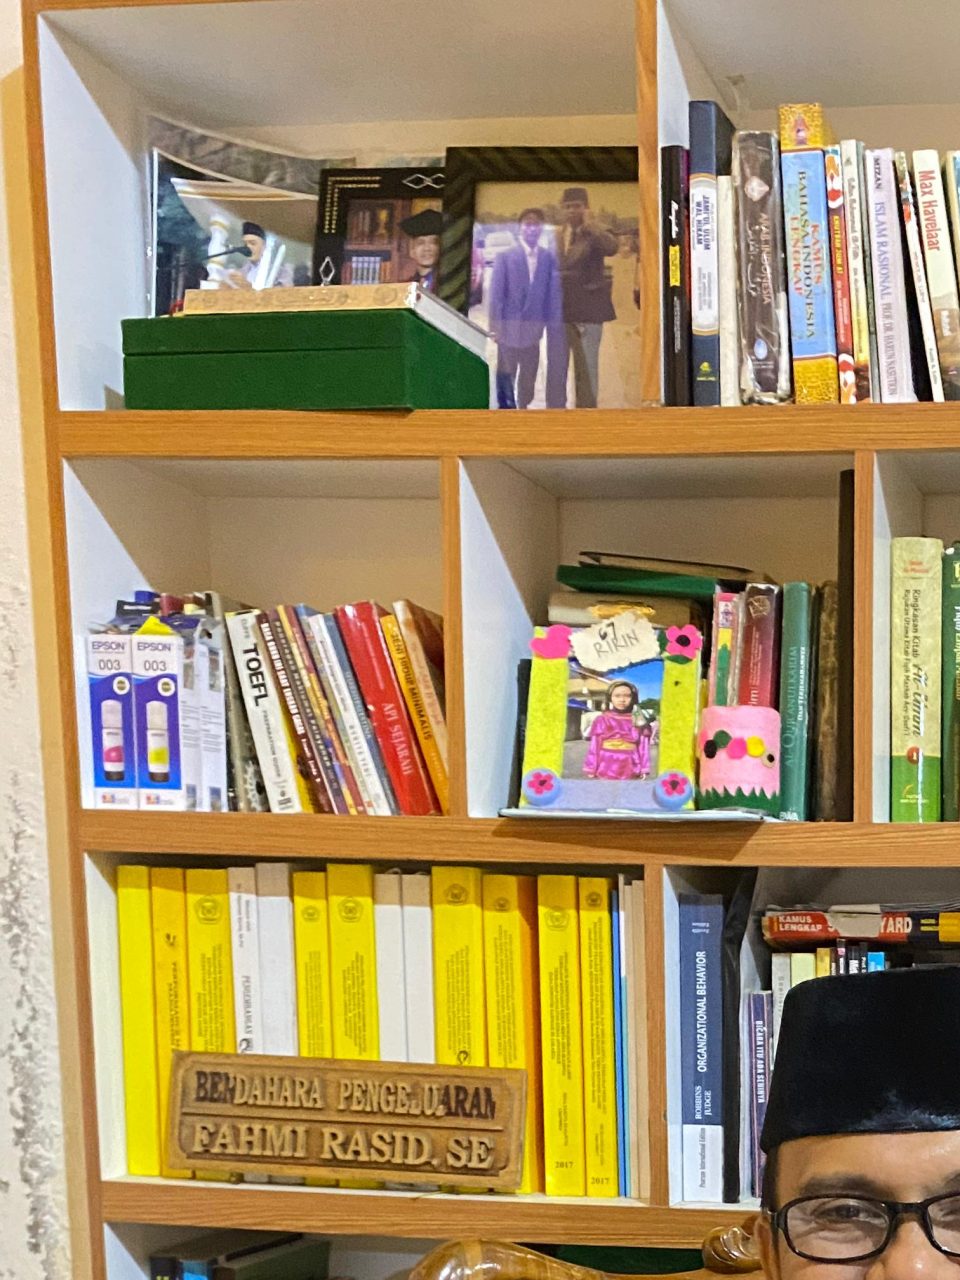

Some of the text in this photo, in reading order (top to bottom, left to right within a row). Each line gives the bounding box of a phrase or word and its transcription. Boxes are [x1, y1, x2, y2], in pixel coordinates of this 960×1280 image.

[873, 156, 883, 190] MIZAN
[695, 200, 703, 219] WAL
[918, 168, 943, 252] Max Havelaar
[790, 214, 804, 297] LENGKAP
[798, 170, 817, 340] BAHASA INDONESIA
[811, 223, 822, 285] KAMUS
[873, 200, 892, 300] ISLAM RASIONAL
[883, 334, 896, 360] HARUN
[885, 360, 898, 396] NASUTION
[598, 621, 618, 640] 67
[911, 588, 920, 658] Ringkasan Kitab
[92, 641, 125, 651] EPSON
[137, 641, 171, 652] EPSON
[98, 659, 121, 671] 003
[143, 660, 167, 672] 003
[243, 643, 269, 706] TOEFL
[274, 670, 290, 687] SAAT
[398, 657, 413, 686] HIDUP
[409, 687, 433, 740] MINIMALIS
[381, 701, 414, 775] API SEJARAH
[778, 915, 813, 923] KAMUS
[779, 923, 823, 932] LENGKAP
[695, 950, 708, 1073] ORGANIZATIONAL BEHAVIOR
[755, 1020, 765, 1103] BICARA ITU ADA SENINYA
[194, 1070, 326, 1109] BENDAHARA
[694, 1085, 703, 1120] ROBBINS
[703, 1089, 712, 1117] JUDGE
[192, 1122, 308, 1159] FAHMI
[446, 1135, 497, 1170] SE
[555, 1161, 575, 1169] 2017
[590, 1177, 610, 1185] 2017
